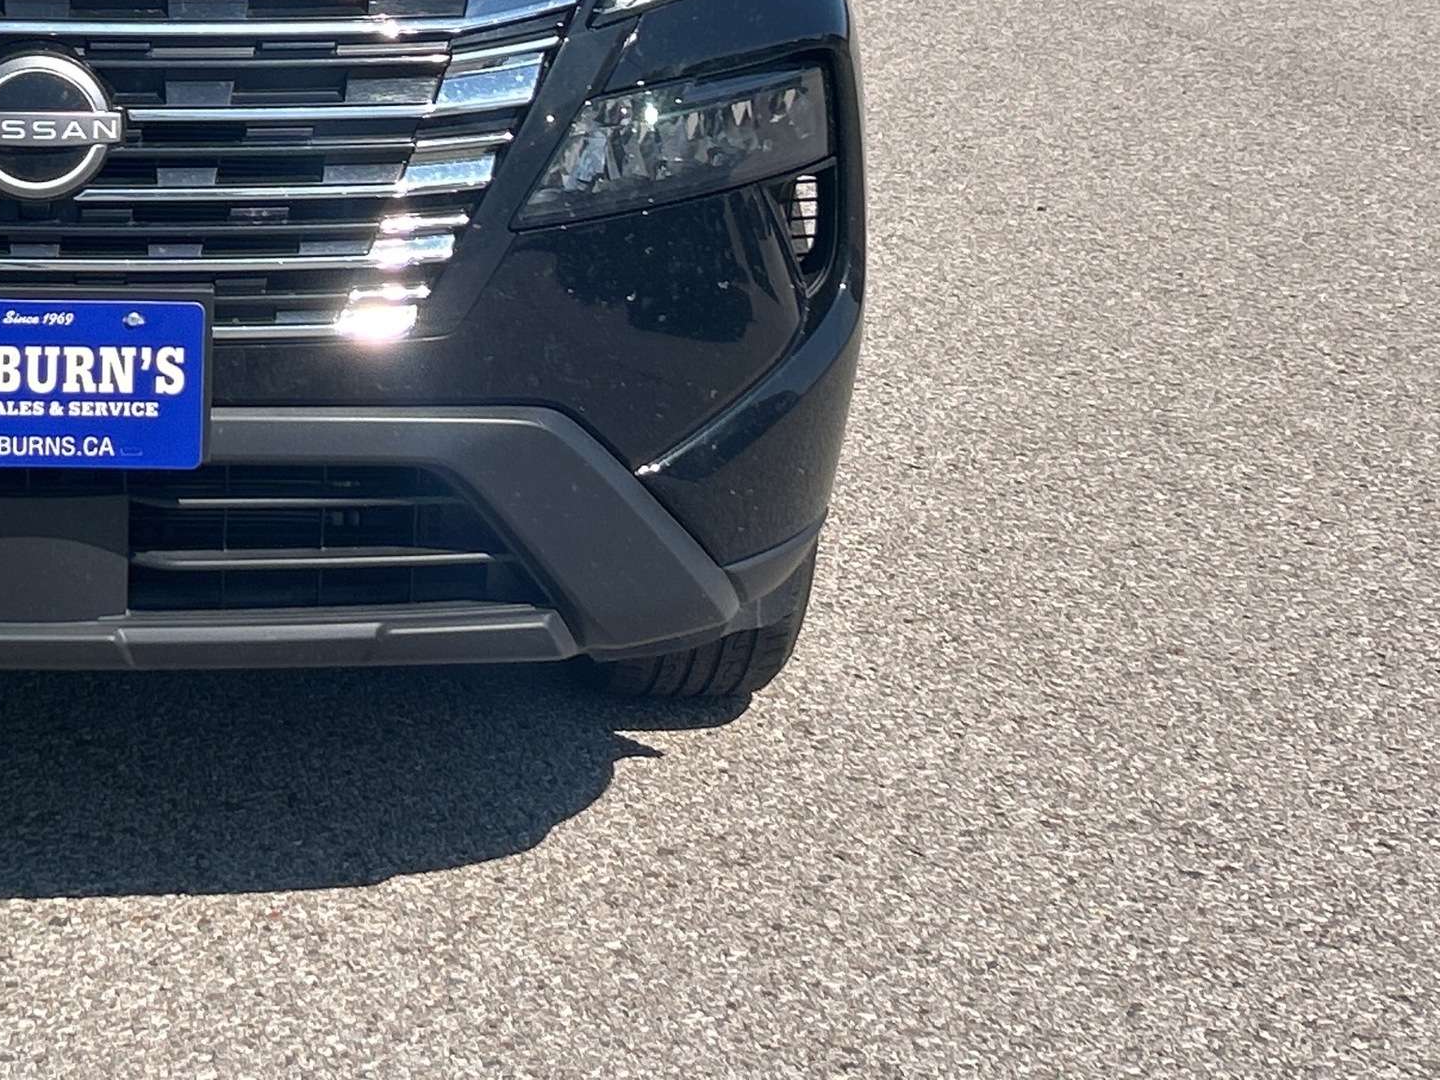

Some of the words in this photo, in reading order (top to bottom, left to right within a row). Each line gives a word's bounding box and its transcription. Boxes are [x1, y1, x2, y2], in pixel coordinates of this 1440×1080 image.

[2, 309, 40, 325] Since
[42, 311, 75, 326] 1969
[48, 400, 65, 417] &
[67, 401, 160, 418] SERVICE
